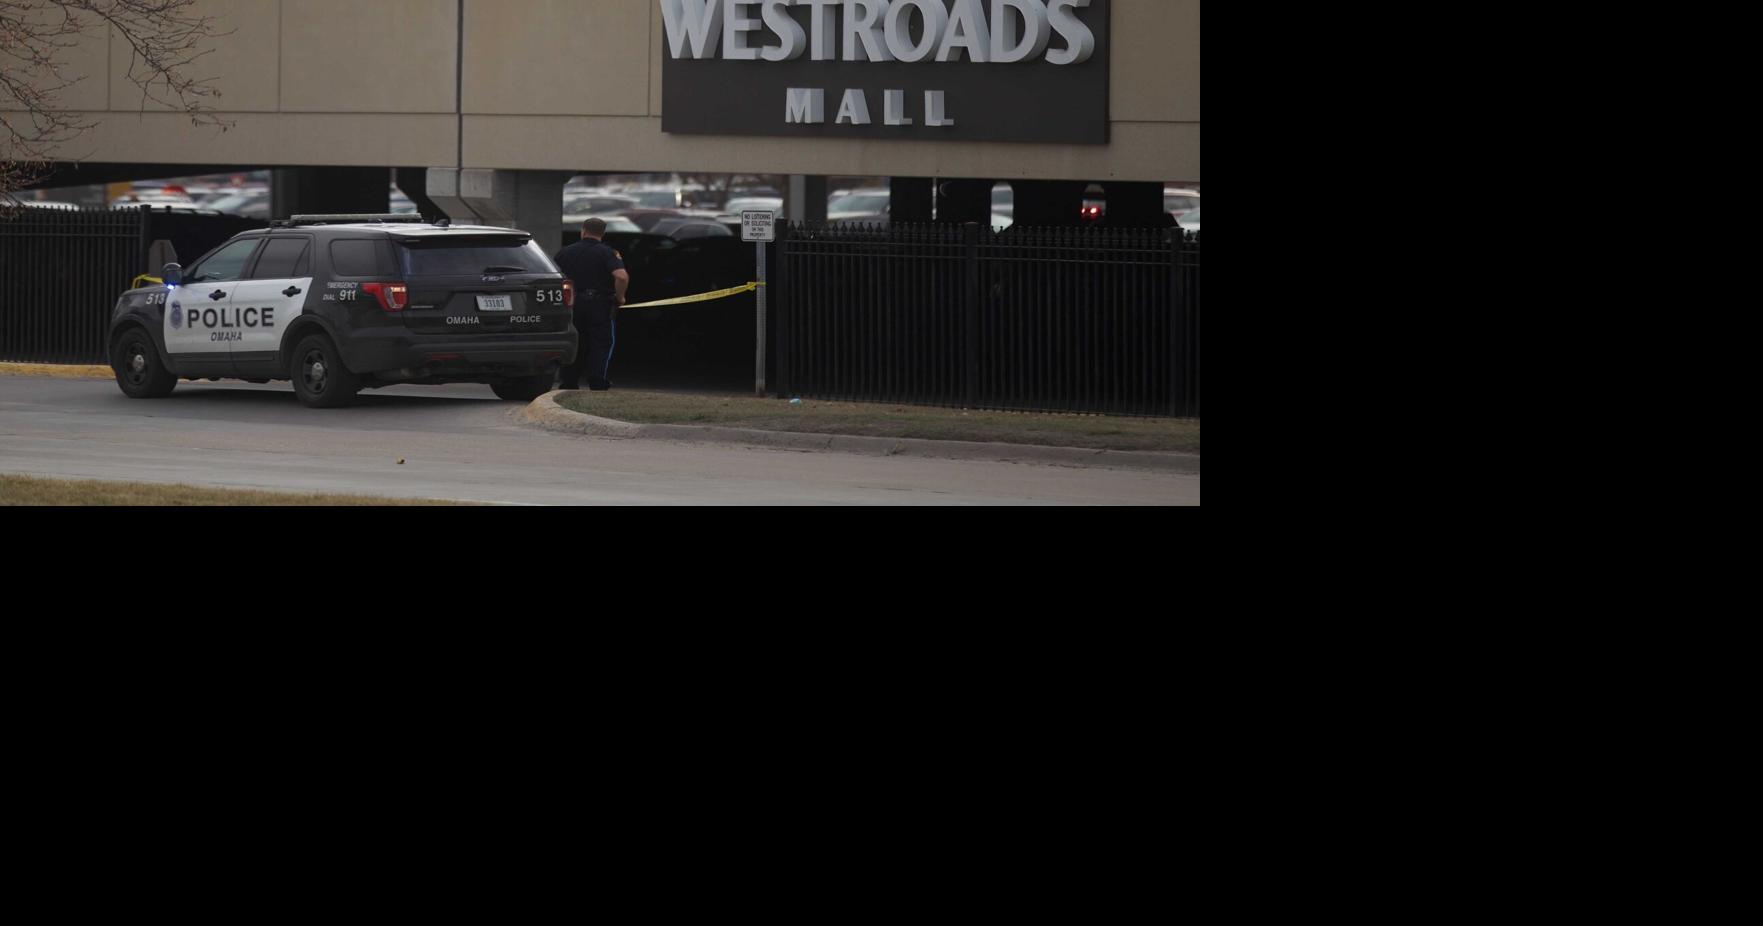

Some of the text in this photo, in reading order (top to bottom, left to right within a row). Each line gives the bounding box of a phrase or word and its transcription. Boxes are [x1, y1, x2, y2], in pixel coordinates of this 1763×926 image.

[661, 0, 1096, 65] WESTROADS
[785, 87, 954, 126] MALL
[145, 293, 166, 305] 513
[322, 289, 356, 301] DIAL 911
[536, 289, 562, 302] 513
[187, 307, 274, 329] POLICE
[446, 316, 480, 325] OMAHA
[510, 315, 541, 323] POLICE
[210, 332, 242, 342] OMAHA
